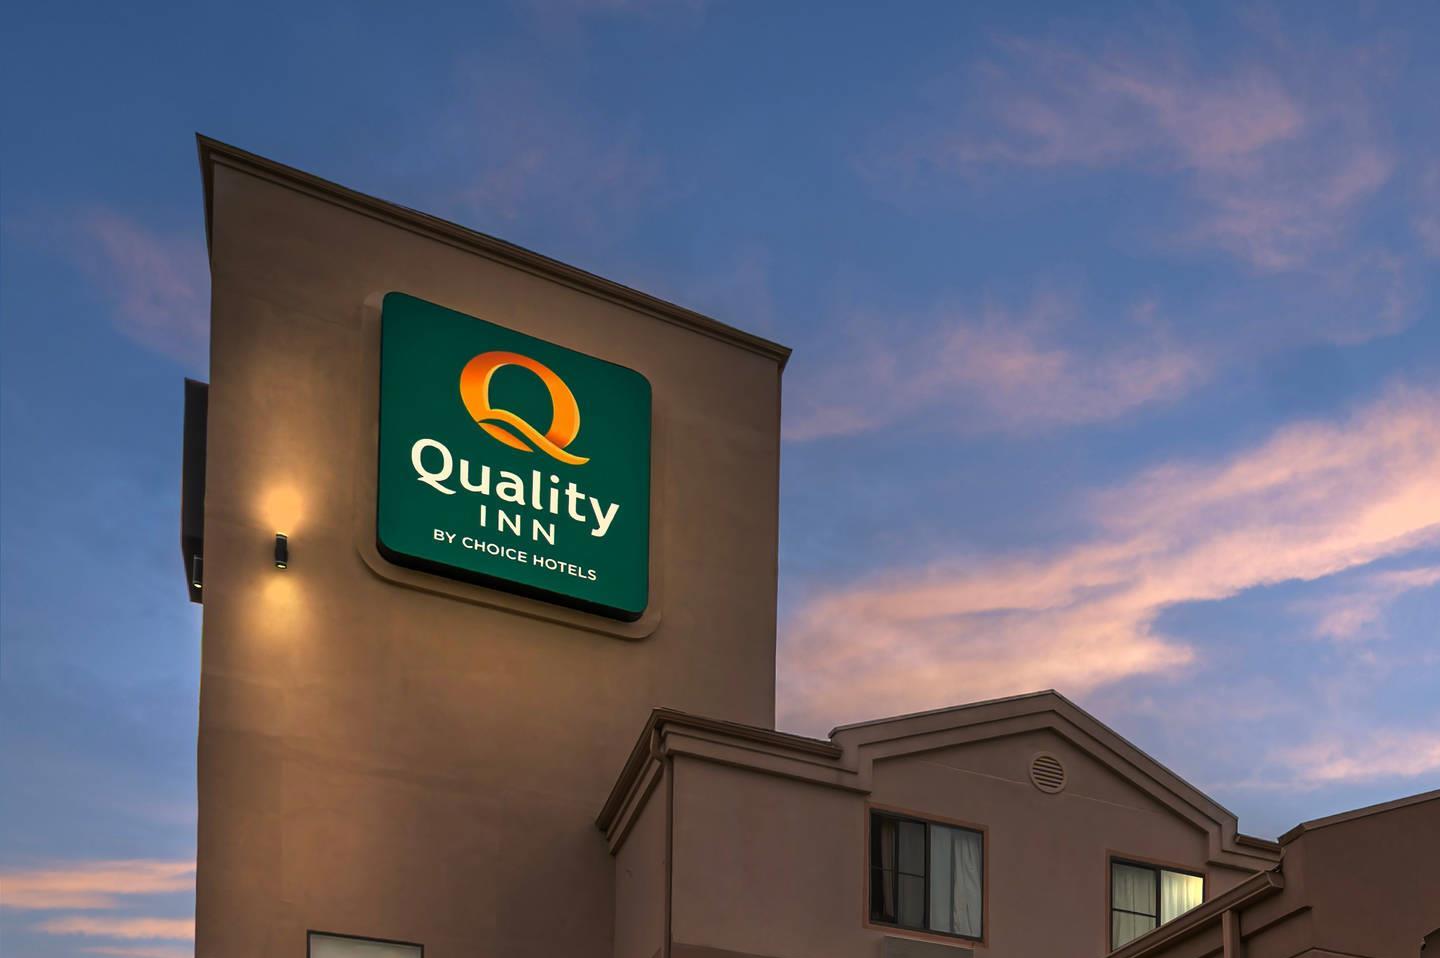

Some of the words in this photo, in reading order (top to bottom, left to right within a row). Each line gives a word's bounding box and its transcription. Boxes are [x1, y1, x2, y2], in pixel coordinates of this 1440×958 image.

[411, 438, 620, 538] Quality
[480, 504, 556, 545] INN
[433, 528, 457, 544] BY
[461, 536, 527, 563] CHOICE
[532, 554, 597, 581] HOTELS
